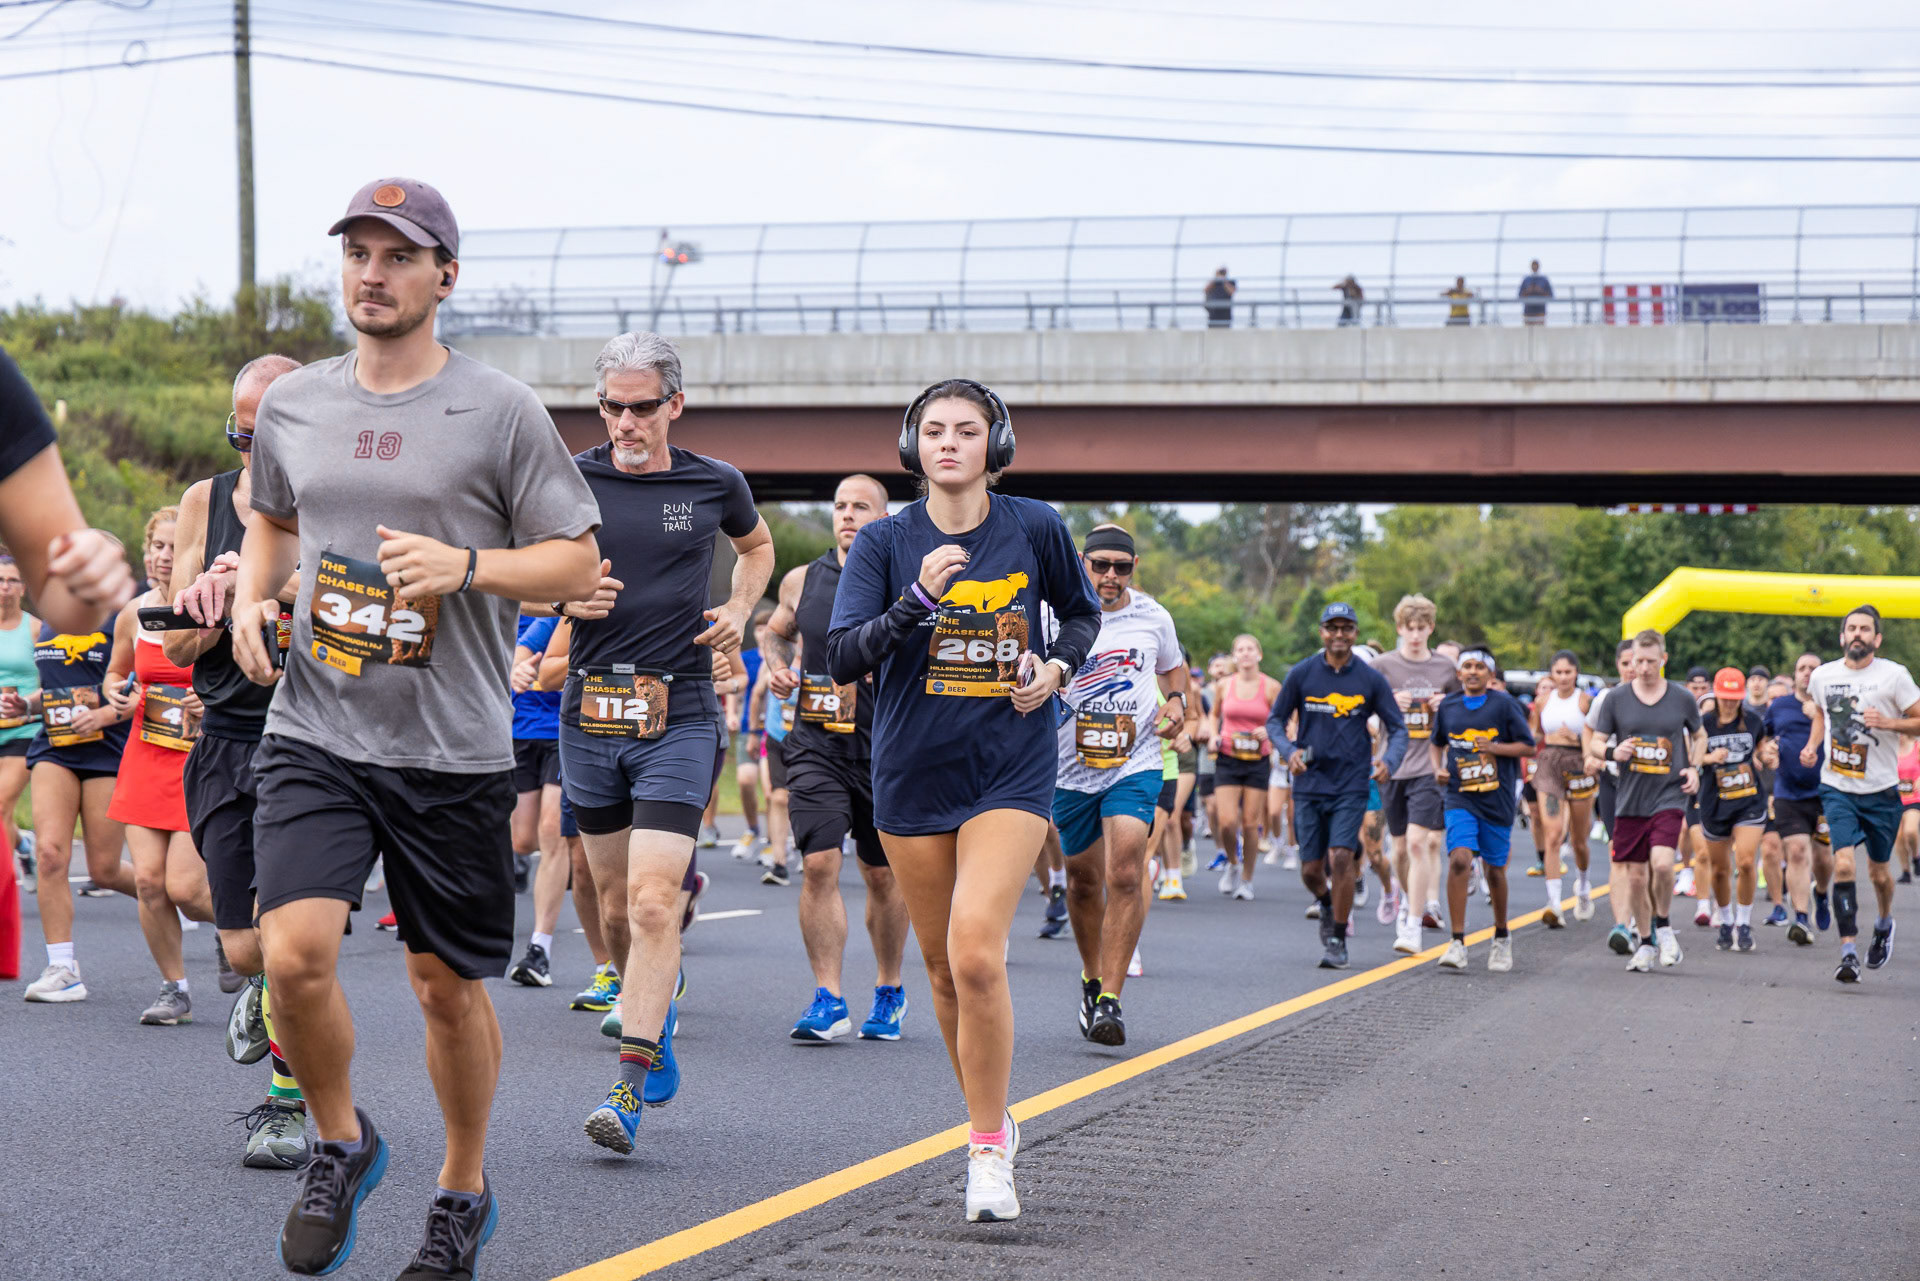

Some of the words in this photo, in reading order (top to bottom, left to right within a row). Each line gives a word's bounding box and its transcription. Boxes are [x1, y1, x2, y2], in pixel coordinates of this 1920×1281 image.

[354, 430, 402, 460] 13
[663, 501, 693, 515] RUN
[662, 520, 693, 532] TRAILS
[321, 559, 348, 575] THE
[317, 573, 365, 594] CHASE
[365, 586, 389, 600] 5K
[318, 593, 426, 643] 342
[939, 615, 960, 626] THE
[935, 626, 976, 637] CHASE
[977, 629, 995, 637] 5K
[368, 641, 383, 650] NJ
[937, 638, 1019, 662] 268
[330, 655, 347, 667] BEER
[929, 665, 982, 673] HILLSBOROUGH
[583, 685, 617, 694] CHASE
[596, 697, 649, 720] 112
[809, 694, 841, 711] 79
[161, 707, 182, 725] 4
[1082, 730, 1129, 748] 281
[1461, 763, 1495, 780] 274
[1721, 772, 1751, 788] 341
